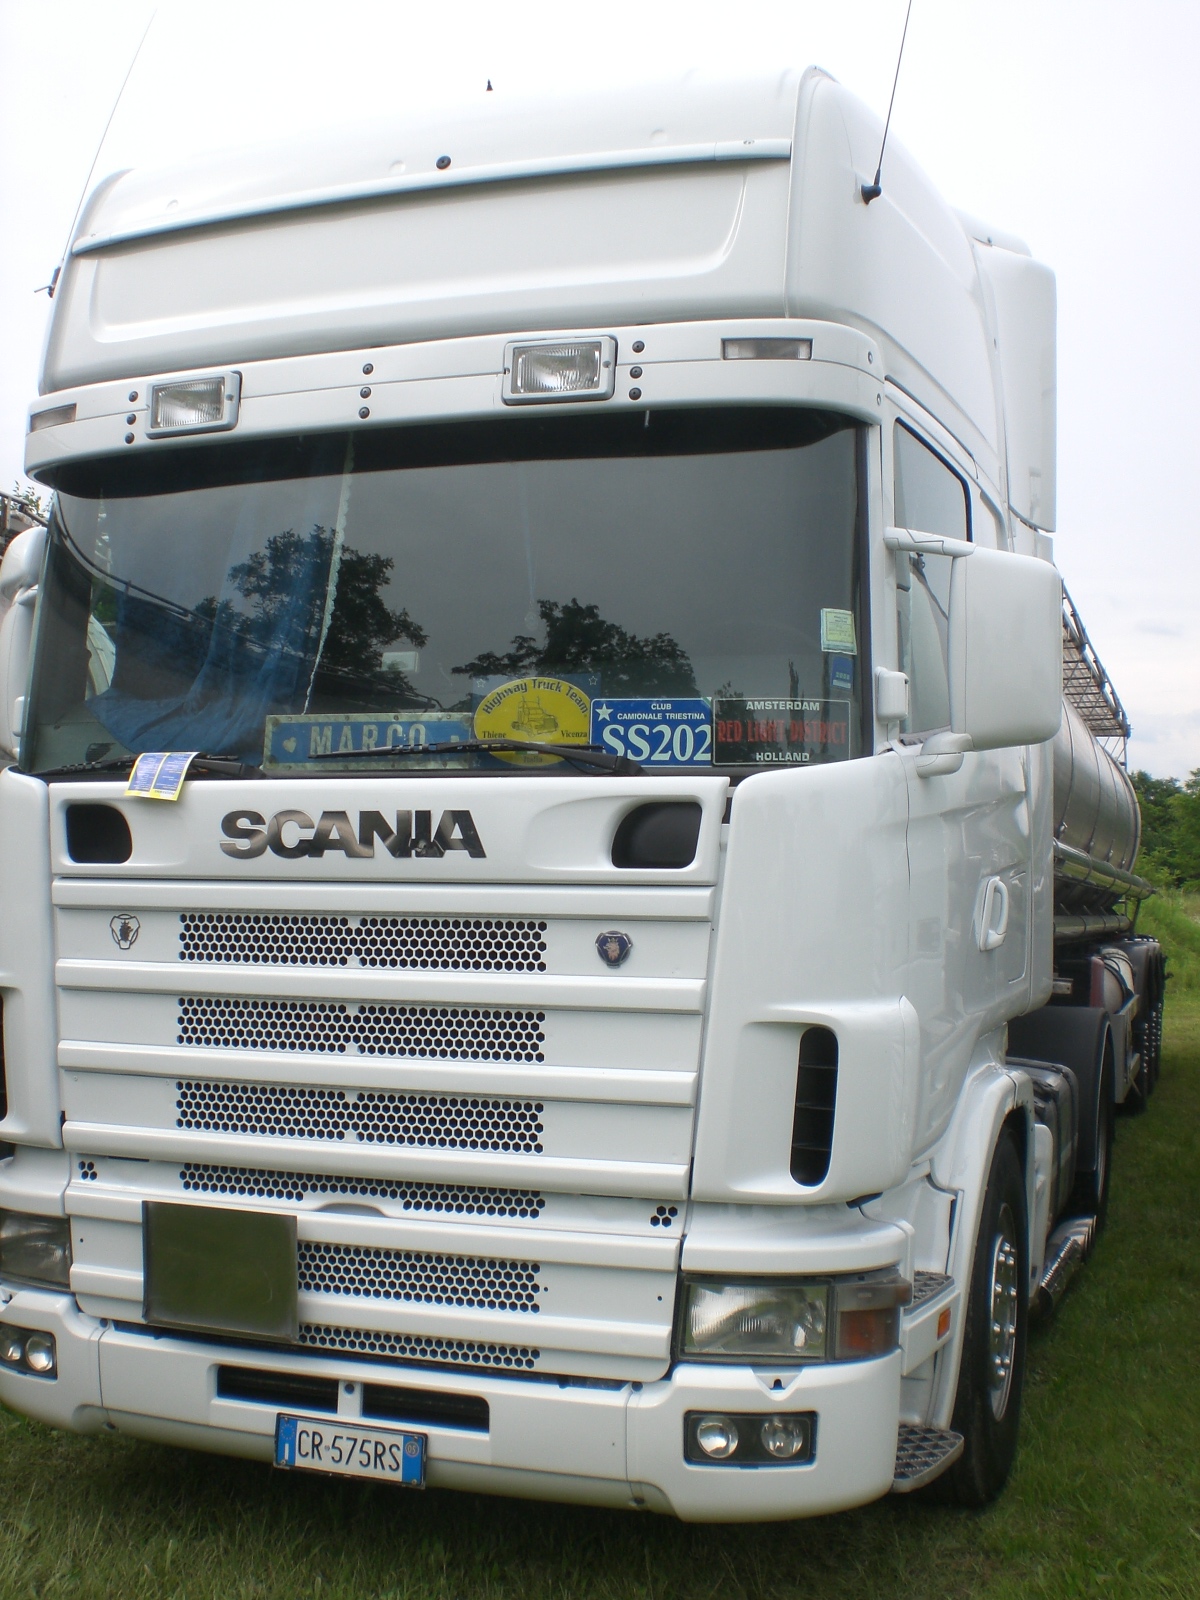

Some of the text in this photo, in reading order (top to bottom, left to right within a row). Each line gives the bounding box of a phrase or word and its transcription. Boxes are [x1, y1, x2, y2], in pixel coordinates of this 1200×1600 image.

[482, 678, 588, 714] Highway Truck Team
[746, 701, 820, 711] AMSTERDAM
[617, 712, 705, 720] CAMIONALE TRIESTINA
[310, 723, 426, 757] MARCO
[560, 730, 588, 738] Vicenza
[602, 724, 711, 761] SS202
[717, 719, 847, 744] RED LIGHT DISTRICT
[755, 752, 810, 762] HOLLAND
[219, 809, 487, 860] SCANIA
